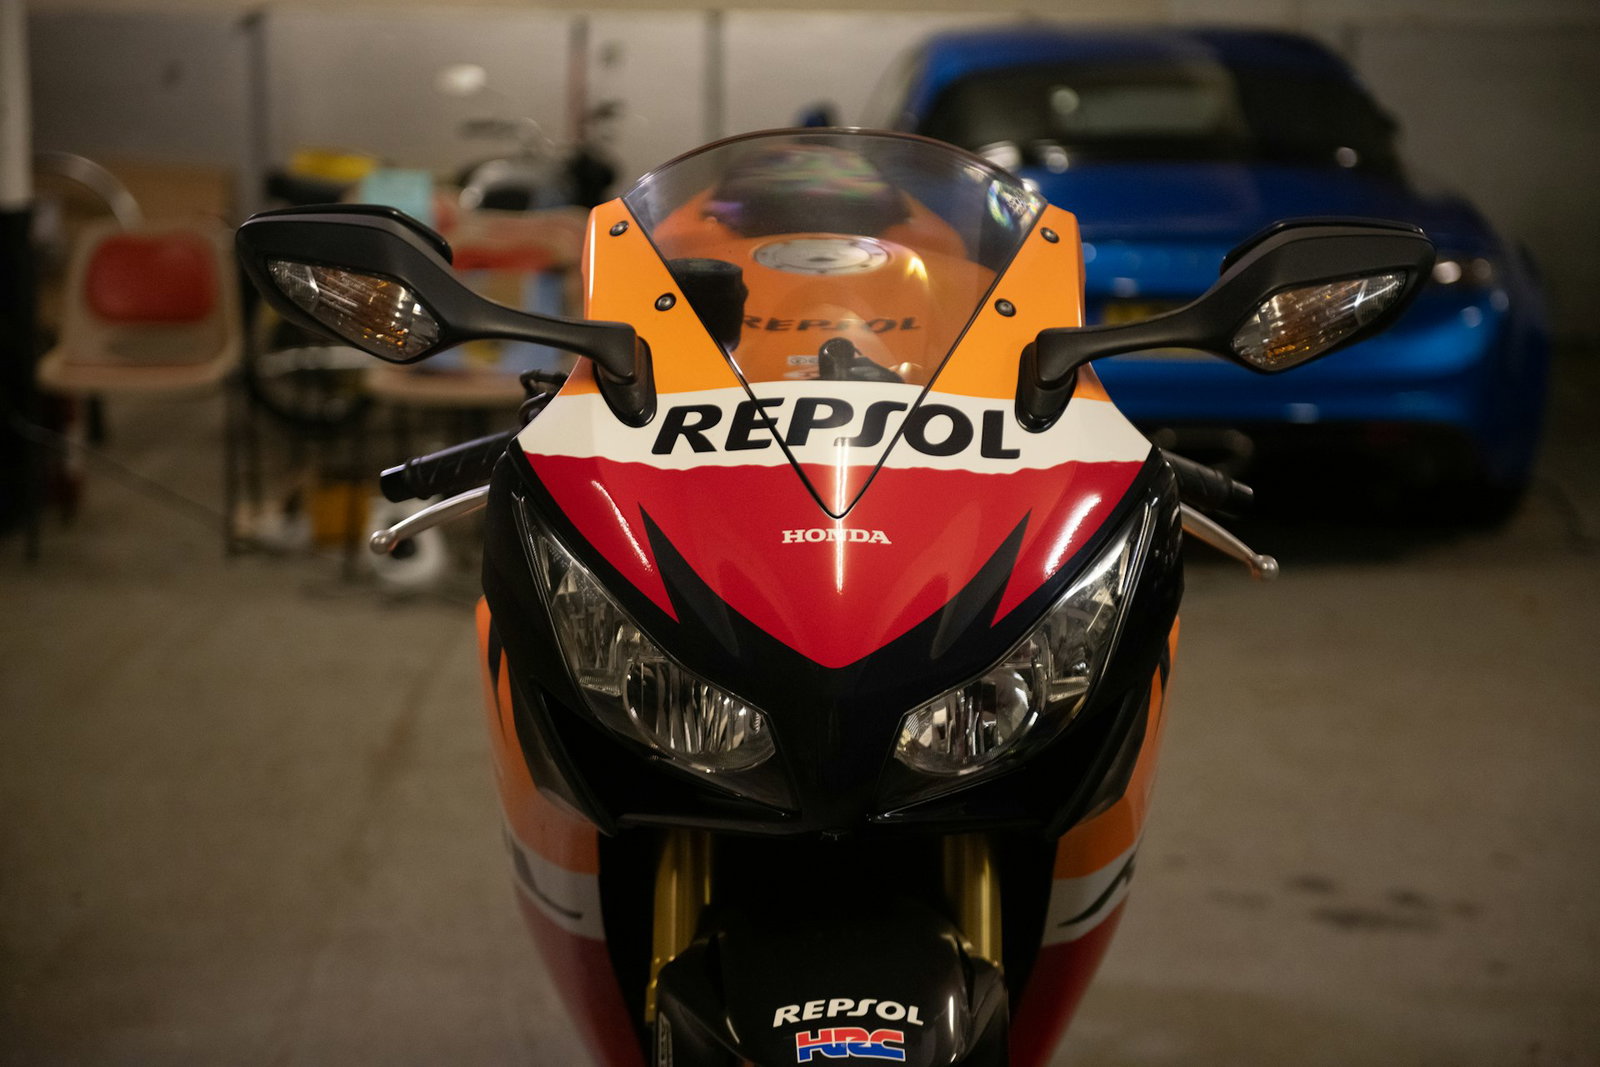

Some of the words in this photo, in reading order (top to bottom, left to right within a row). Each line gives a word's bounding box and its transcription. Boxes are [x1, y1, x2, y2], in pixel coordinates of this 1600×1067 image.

[651, 397, 1021, 459] REPSOL
[782, 529, 892, 545] HONDA
[773, 998, 924, 1027] REPSOL
[796, 1027, 906, 1063] HRC
